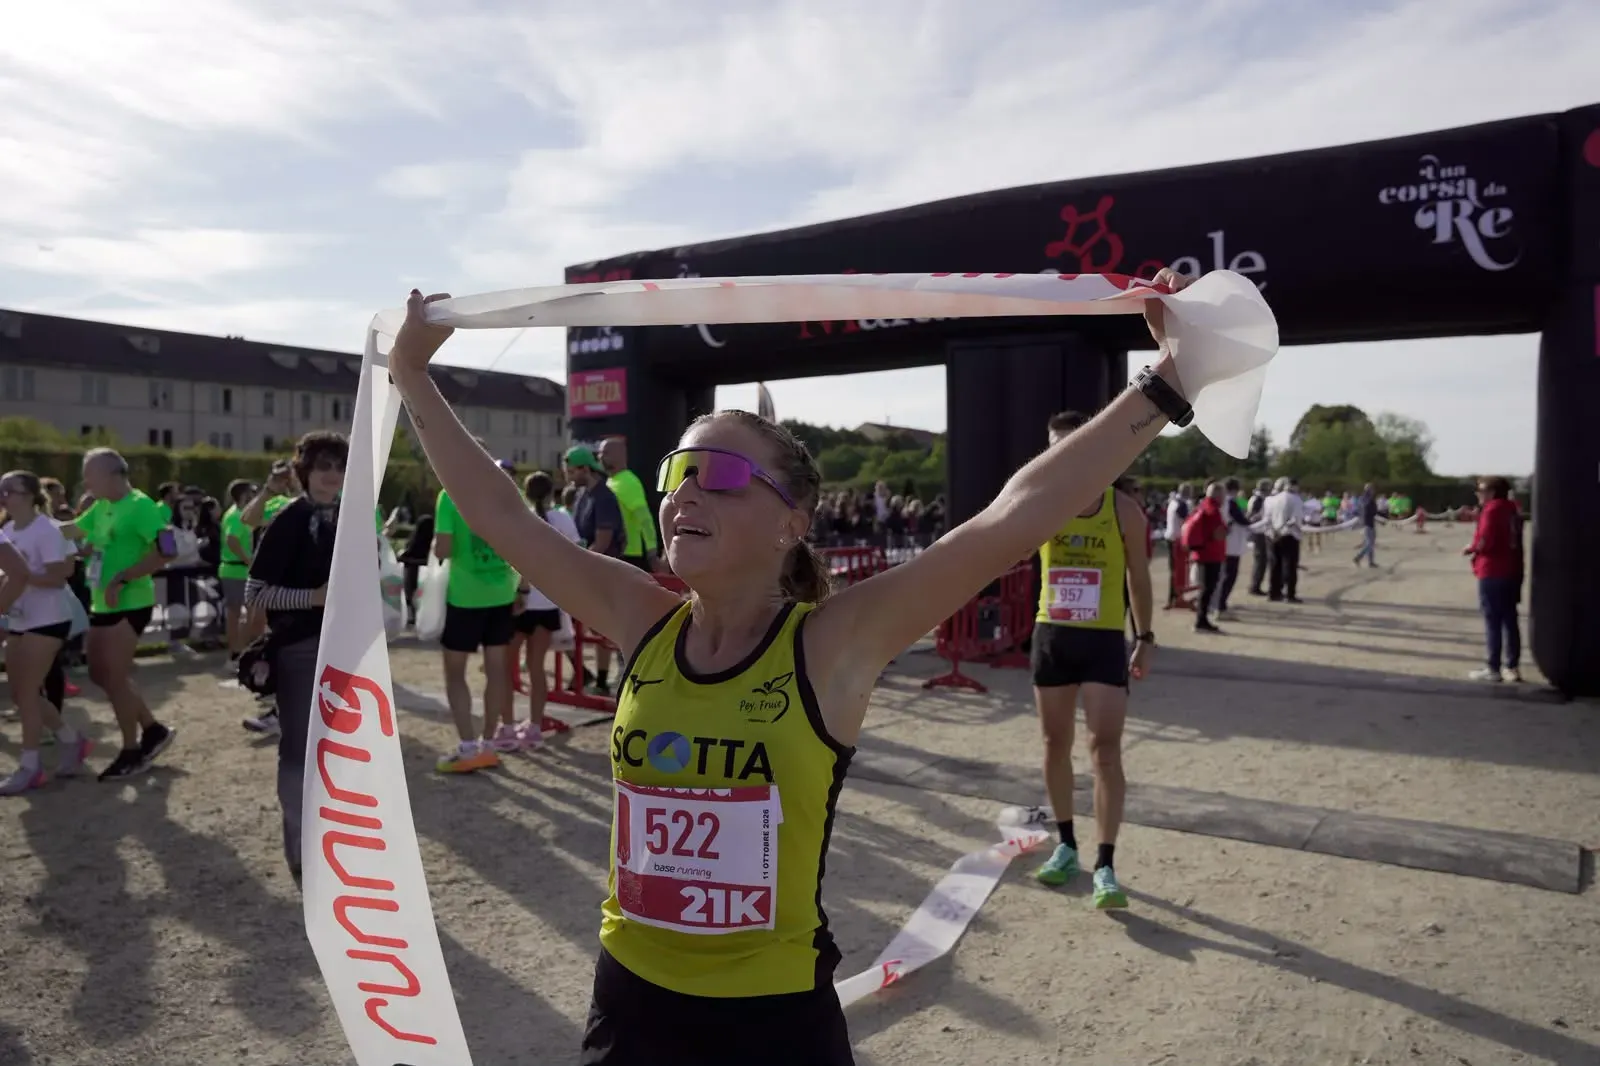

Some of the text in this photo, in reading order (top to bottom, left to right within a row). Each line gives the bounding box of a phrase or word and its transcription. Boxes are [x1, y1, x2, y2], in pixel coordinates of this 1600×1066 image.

[1378, 177, 1485, 205] corsa
[1414, 199, 1522, 271] Re
[1060, 587, 1084, 602] 957
[612, 725, 775, 783] SCOTTA
[645, 807, 721, 860] 522
[316, 664, 437, 1045] running
[653, 862, 712, 879] base running
[762, 870, 769, 880] 11
[679, 885, 769, 925] 21K
